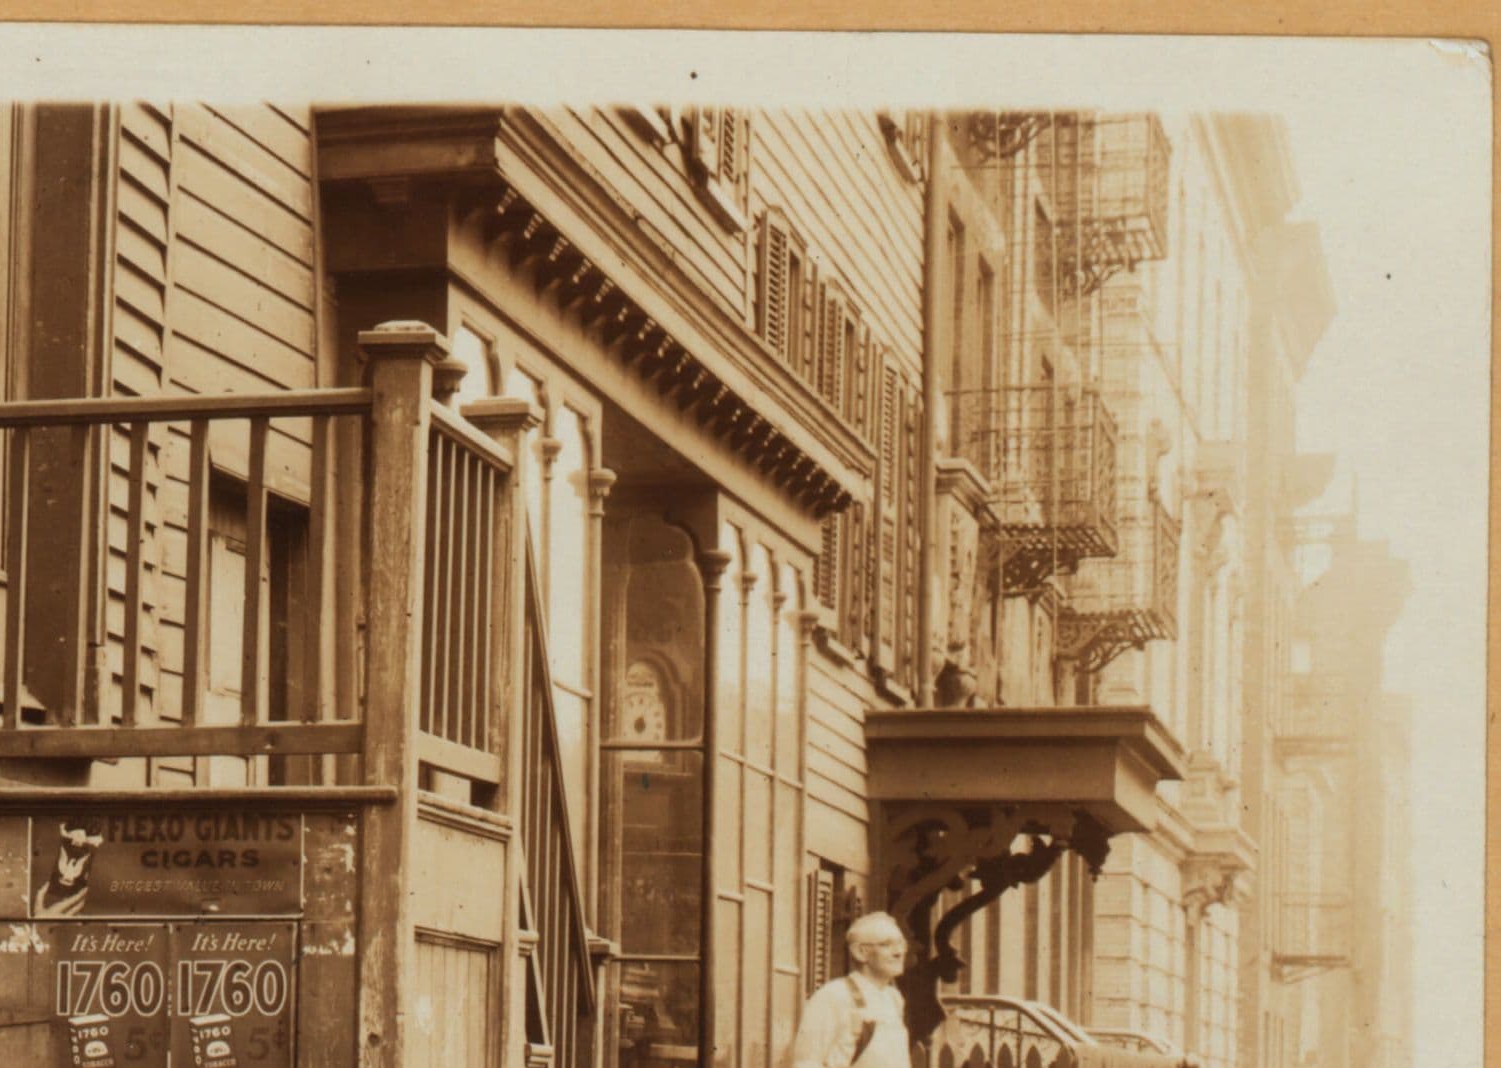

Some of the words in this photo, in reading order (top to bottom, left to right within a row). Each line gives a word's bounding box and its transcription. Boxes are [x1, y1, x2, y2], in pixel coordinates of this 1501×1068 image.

[194, 813, 294, 843] GIANTS
[140, 850, 260, 869] CIGARS
[109, 880, 173, 893] BIGGEST
[70, 934, 97, 953] It's
[102, 935, 154, 953] Here!
[191, 933, 218, 952] It's
[222, 933, 277, 952] Here!
[56, 960, 164, 1017] 1760
[177, 959, 287, 1017] 1760
[200, 1025, 231, 1040] 1760
